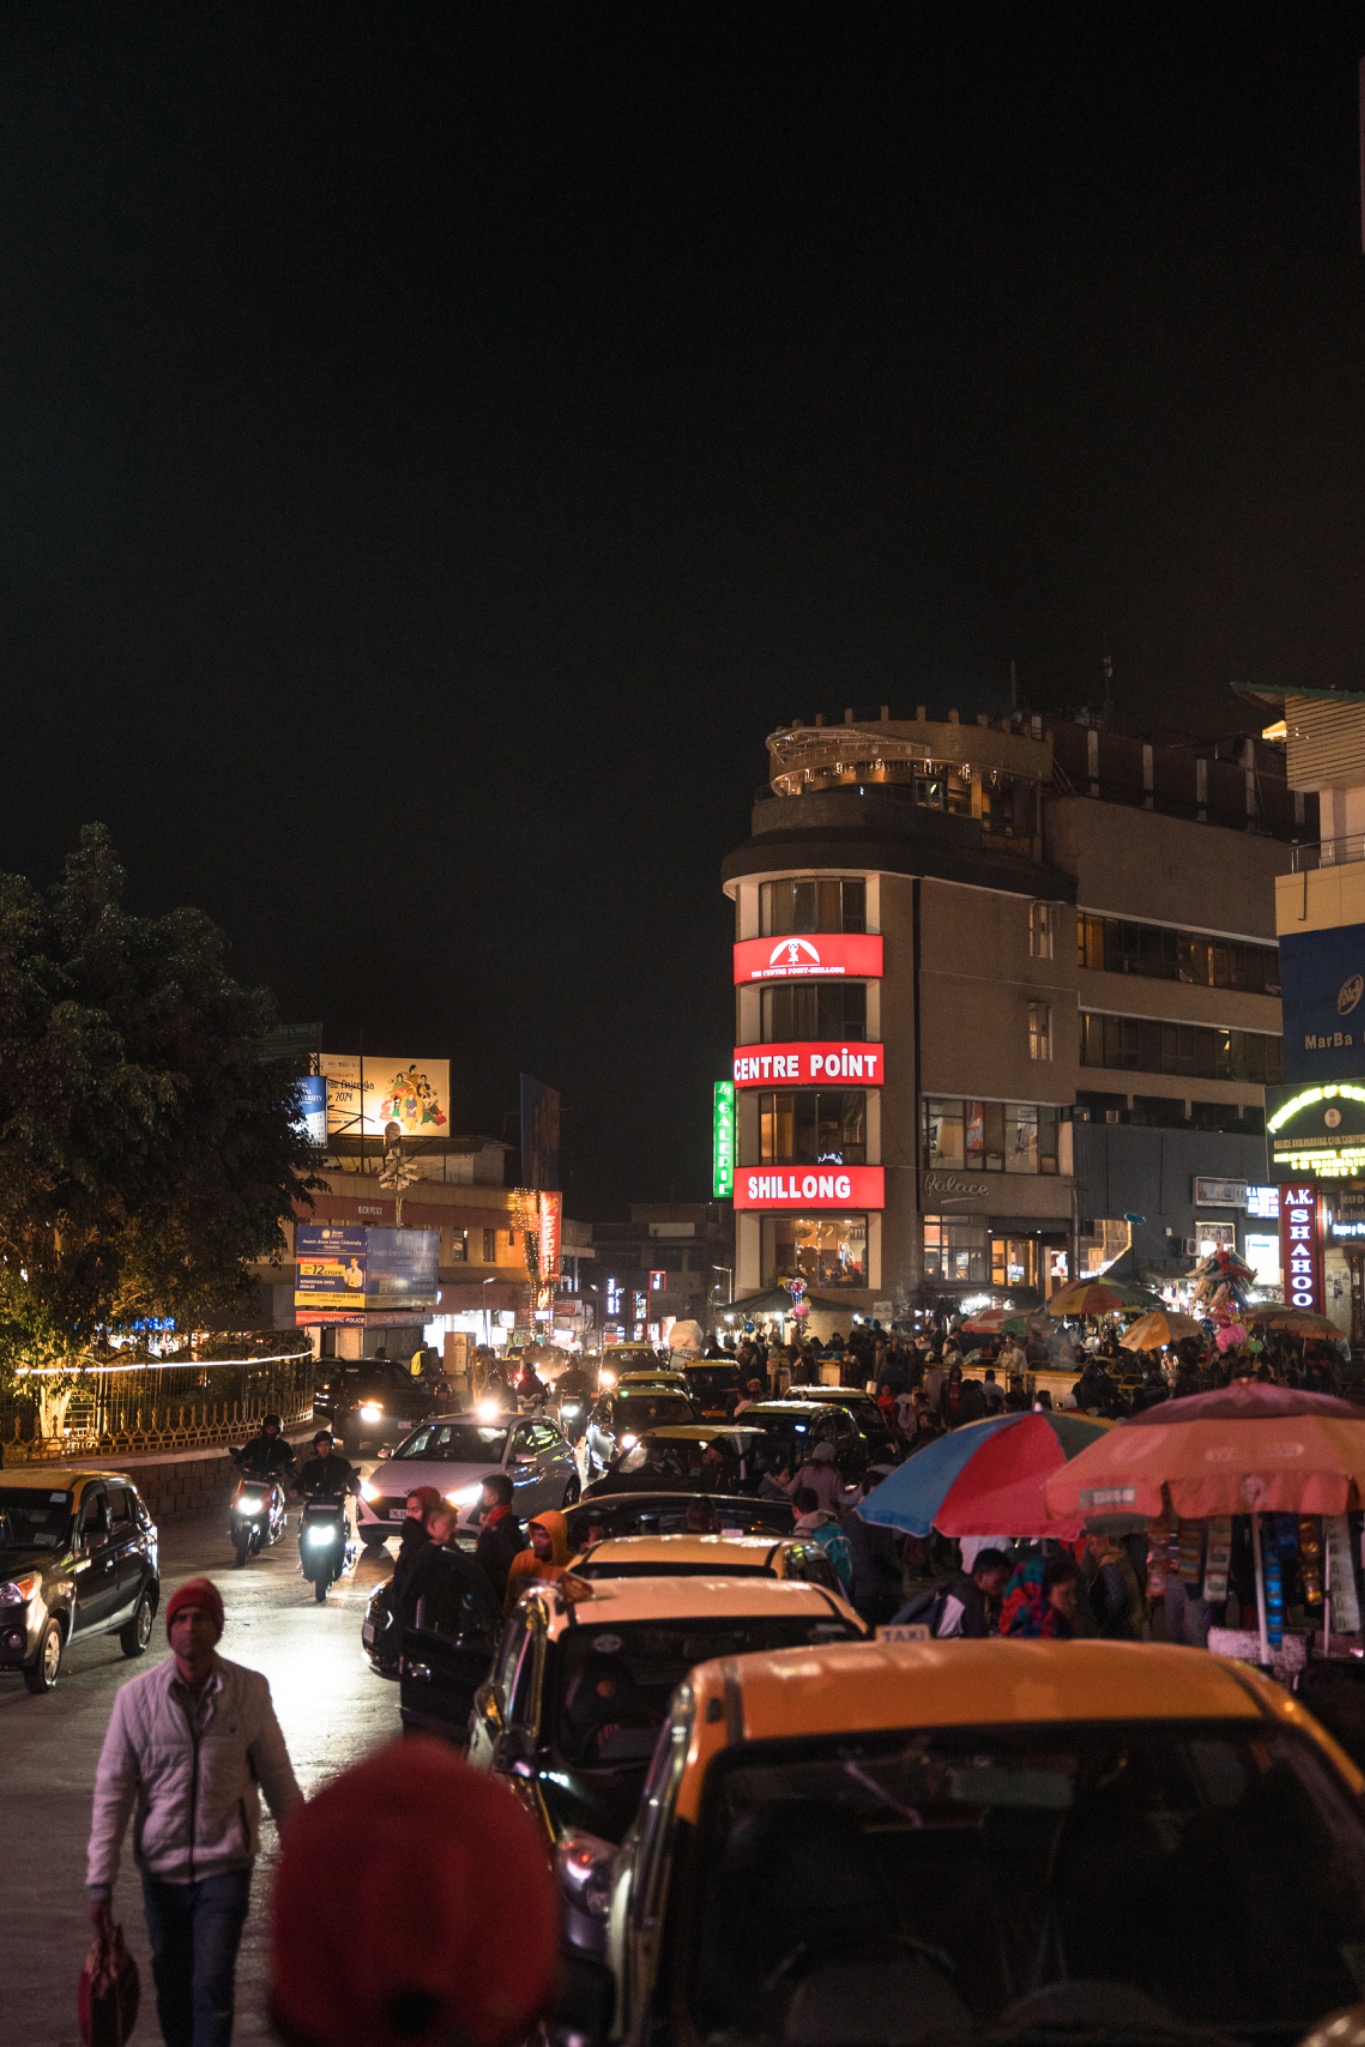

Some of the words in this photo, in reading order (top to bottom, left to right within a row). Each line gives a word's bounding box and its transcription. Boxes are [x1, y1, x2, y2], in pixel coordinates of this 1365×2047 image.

[763, 968, 787, 976] CENTRE
[1304, 1031, 1353, 1050] MarBa
[734, 1055, 800, 1081] CENTRE
[335, 1092, 353, 1102] 2024
[717, 1102, 731, 1195] GALERIE
[748, 1175, 851, 1199] SHILLONG
[924, 1172, 990, 1197] Palace
[1284, 1189, 1313, 1205] A.K.
[1289, 1208, 1313, 1307] SHAHOO
[312, 1265, 325, 1276] 12
[883, 1630, 925, 1642] TAXI
